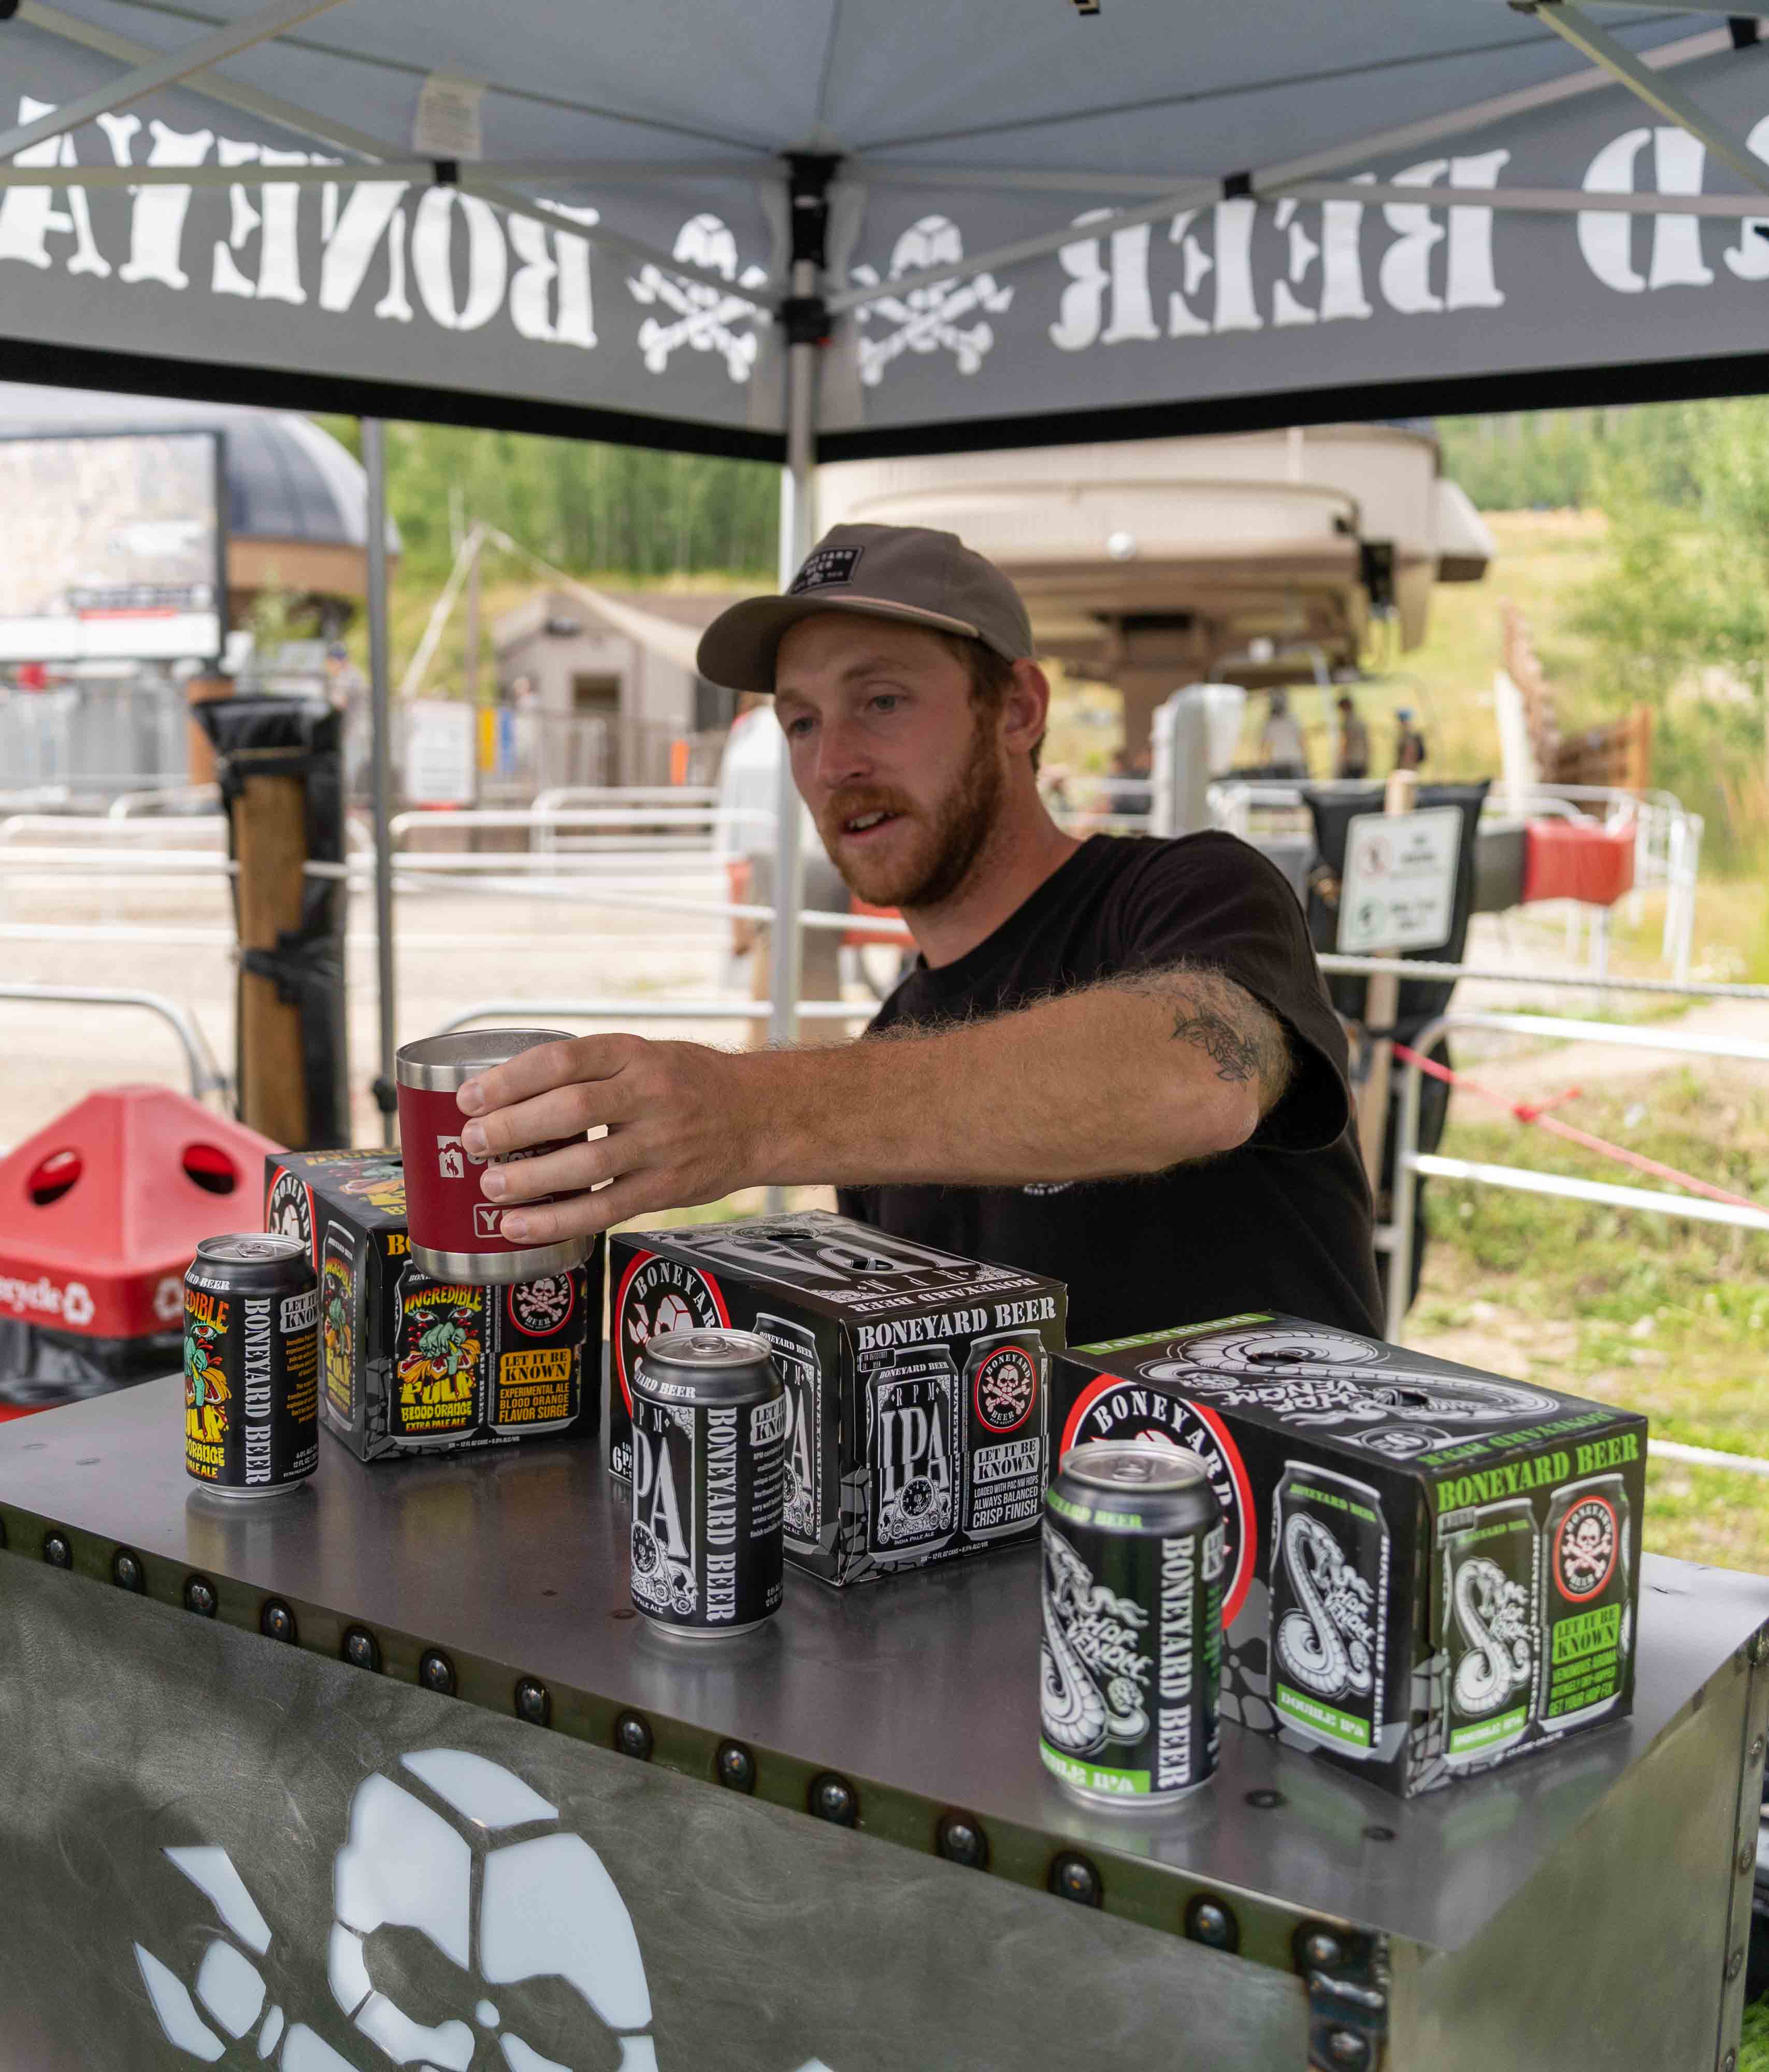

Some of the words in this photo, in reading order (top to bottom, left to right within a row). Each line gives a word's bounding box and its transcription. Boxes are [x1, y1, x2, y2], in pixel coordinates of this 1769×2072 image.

[199, 1277, 231, 1290] BEER
[634, 1262, 715, 1329] BONEYAR
[918, 1277, 1040, 1301] BONEYARD
[285, 1297, 306, 1313] LET
[405, 1285, 484, 1314] INCREDIBLE
[847, 1296, 916, 1313] BEER
[285, 1306, 316, 1329] KNO
[526, 1317, 551, 1327] BEER
[857, 1307, 988, 1351] BONEYARD
[995, 1296, 1057, 1328] BEER
[245, 1298, 271, 1418] BONEYARD
[759, 1331, 795, 1350] BONEYARD
[796, 1344, 813, 1359] BEER
[505, 1355, 529, 1367] LET
[533, 1353, 546, 1364] IT
[550, 1351, 567, 1363] BE
[879, 1364, 927, 1379] BONEYARD
[928, 1361, 949, 1371] BEER
[986, 1354, 1031, 1378] BONEYARD
[505, 1363, 567, 1382] KNOWN
[634, 1372, 658, 1391] YARD
[659, 1382, 696, 1399] BEER
[400, 1371, 472, 1404] PULP
[500, 1384, 555, 1399] EXPERIMENTAL
[556, 1382, 569, 1393] ALE
[401, 1405, 434, 1421] BLOOD
[435, 1401, 472, 1418] ORANGE
[499, 1407, 536, 1423] FLAVOR
[537, 1403, 569, 1419] SURGE
[500, 1398, 530, 1410] BLOOD
[533, 1393, 569, 1406] ORANGE
[756, 1405, 776, 1422] LET
[406, 1421, 431, 1432] EXTRA
[432, 1418, 450, 1429] PALE
[452, 1417, 467, 1427] ALE
[756, 1415, 785, 1441] KNO
[991, 1409, 1015, 1421] BEER
[245, 1424, 272, 1485] BEER
[613, 1446, 623, 1472] 6
[622, 1450, 632, 1469] PA
[881, 1402, 950, 1503] IPA
[978, 1448, 1000, 1463] LET
[1004, 1444, 1017, 1458] IT
[1020, 1440, 1037, 1455] BE
[1092, 1390, 1233, 1506] BONEYARD
[201, 1466, 220, 1479] ALE
[707, 1407, 737, 1545] BONEYARD
[978, 1453, 1036, 1480] KNOWN
[1437, 1451, 1571, 1513] BONEYARD
[1575, 1433, 1639, 1476] BEER
[632, 1424, 689, 1559] PA
[974, 1486, 994, 1498] LOADED
[994, 1483, 1006, 1493] WITH
[1008, 1479, 1016, 1491] PAC
[1017, 1477, 1026, 1488] NW
[1026, 1475, 1039, 1486] HOPS
[974, 1495, 1002, 1512] ALWAYS
[1003, 1486, 1038, 1505] BALANCED
[973, 1506, 1003, 1528] CRISP
[1005, 1498, 1038, 1521] FINISH
[706, 1552, 736, 1622] BEER
[650, 1603, 664, 1614] ALE
[1160, 1535, 1195, 1699] BONEYARD
[1558, 1620, 1579, 1638] LET
[1584, 1614, 1596, 1630] IT
[1600, 1607, 1616, 1621] BE
[1557, 1625, 1615, 1658] KNOWN
[1158, 1705, 1191, 1789] BEER
